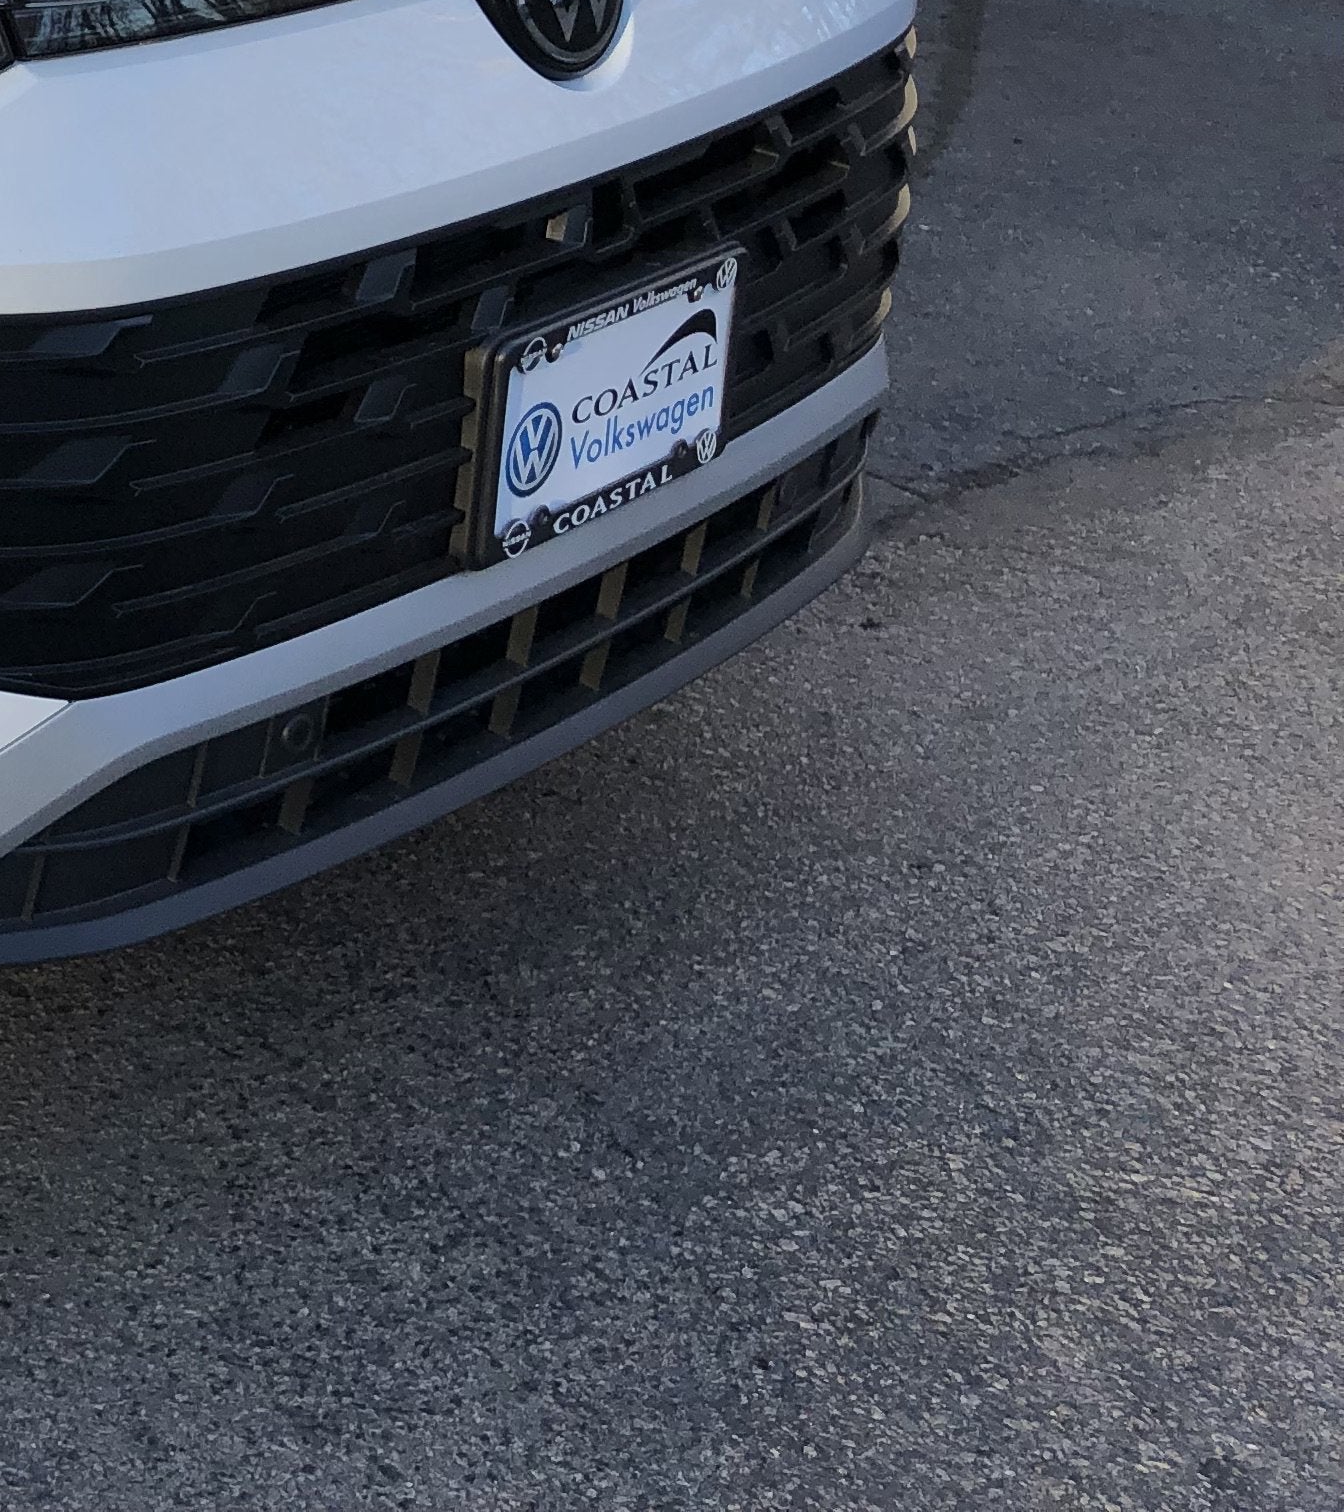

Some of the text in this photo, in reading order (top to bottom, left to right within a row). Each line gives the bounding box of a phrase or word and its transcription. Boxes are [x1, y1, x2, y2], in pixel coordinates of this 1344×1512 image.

[566, 277, 698, 341] NISSAN Volkswagen
[571, 343, 718, 424] COASTAL
[570, 385, 714, 469] Volkswagen
[552, 464, 673, 534] COASTAL
